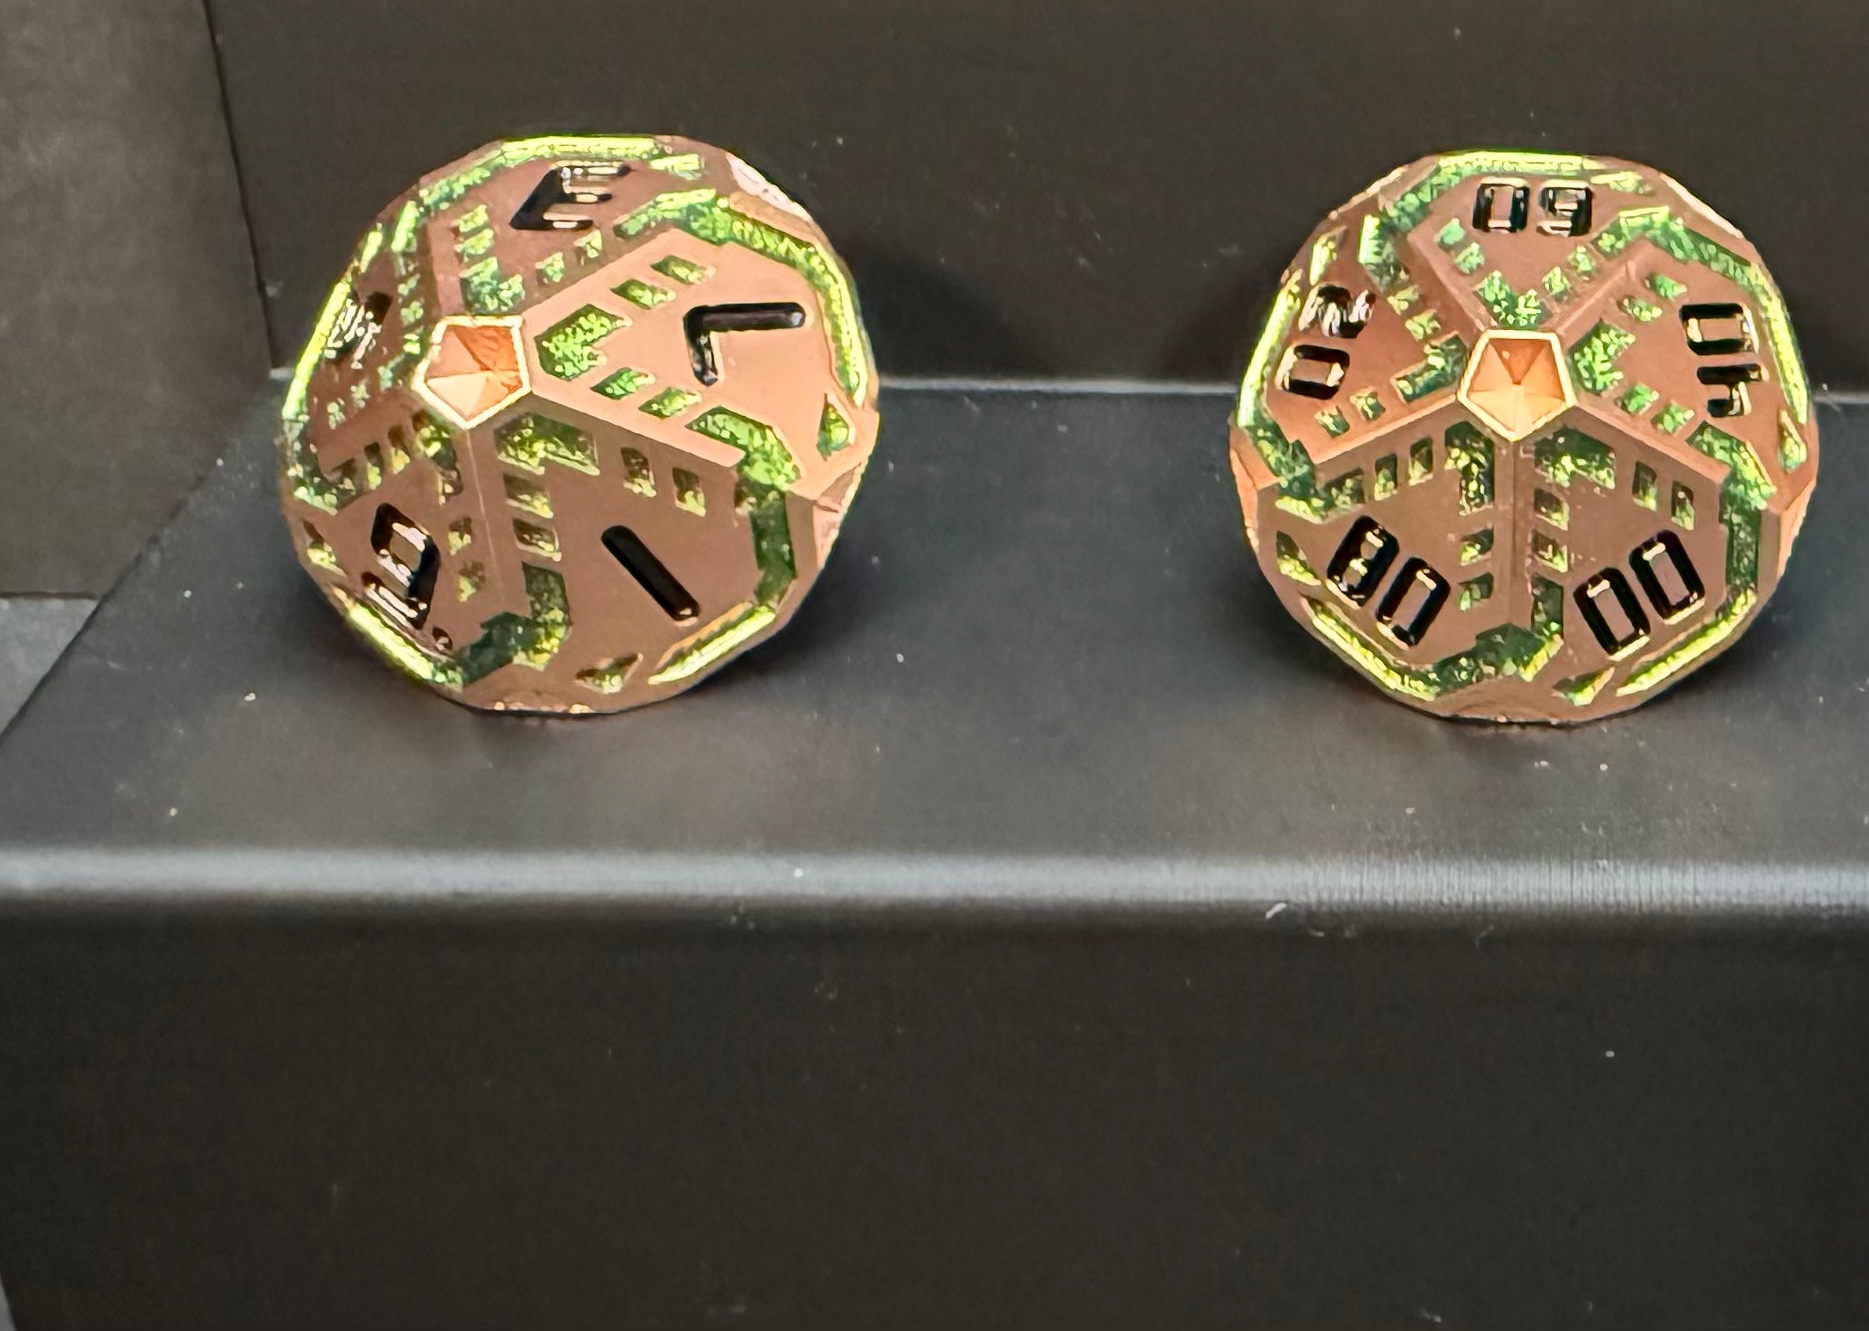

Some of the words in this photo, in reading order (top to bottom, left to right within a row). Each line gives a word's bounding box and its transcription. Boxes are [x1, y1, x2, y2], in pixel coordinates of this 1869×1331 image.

[508, 161, 632, 230] 3
[683, 301, 807, 387] 7
[1678, 301, 1770, 418] 40
[600, 524, 699, 623] 1
[1325, 515, 1451, 650] 80
[1573, 529, 1706, 660] 00
